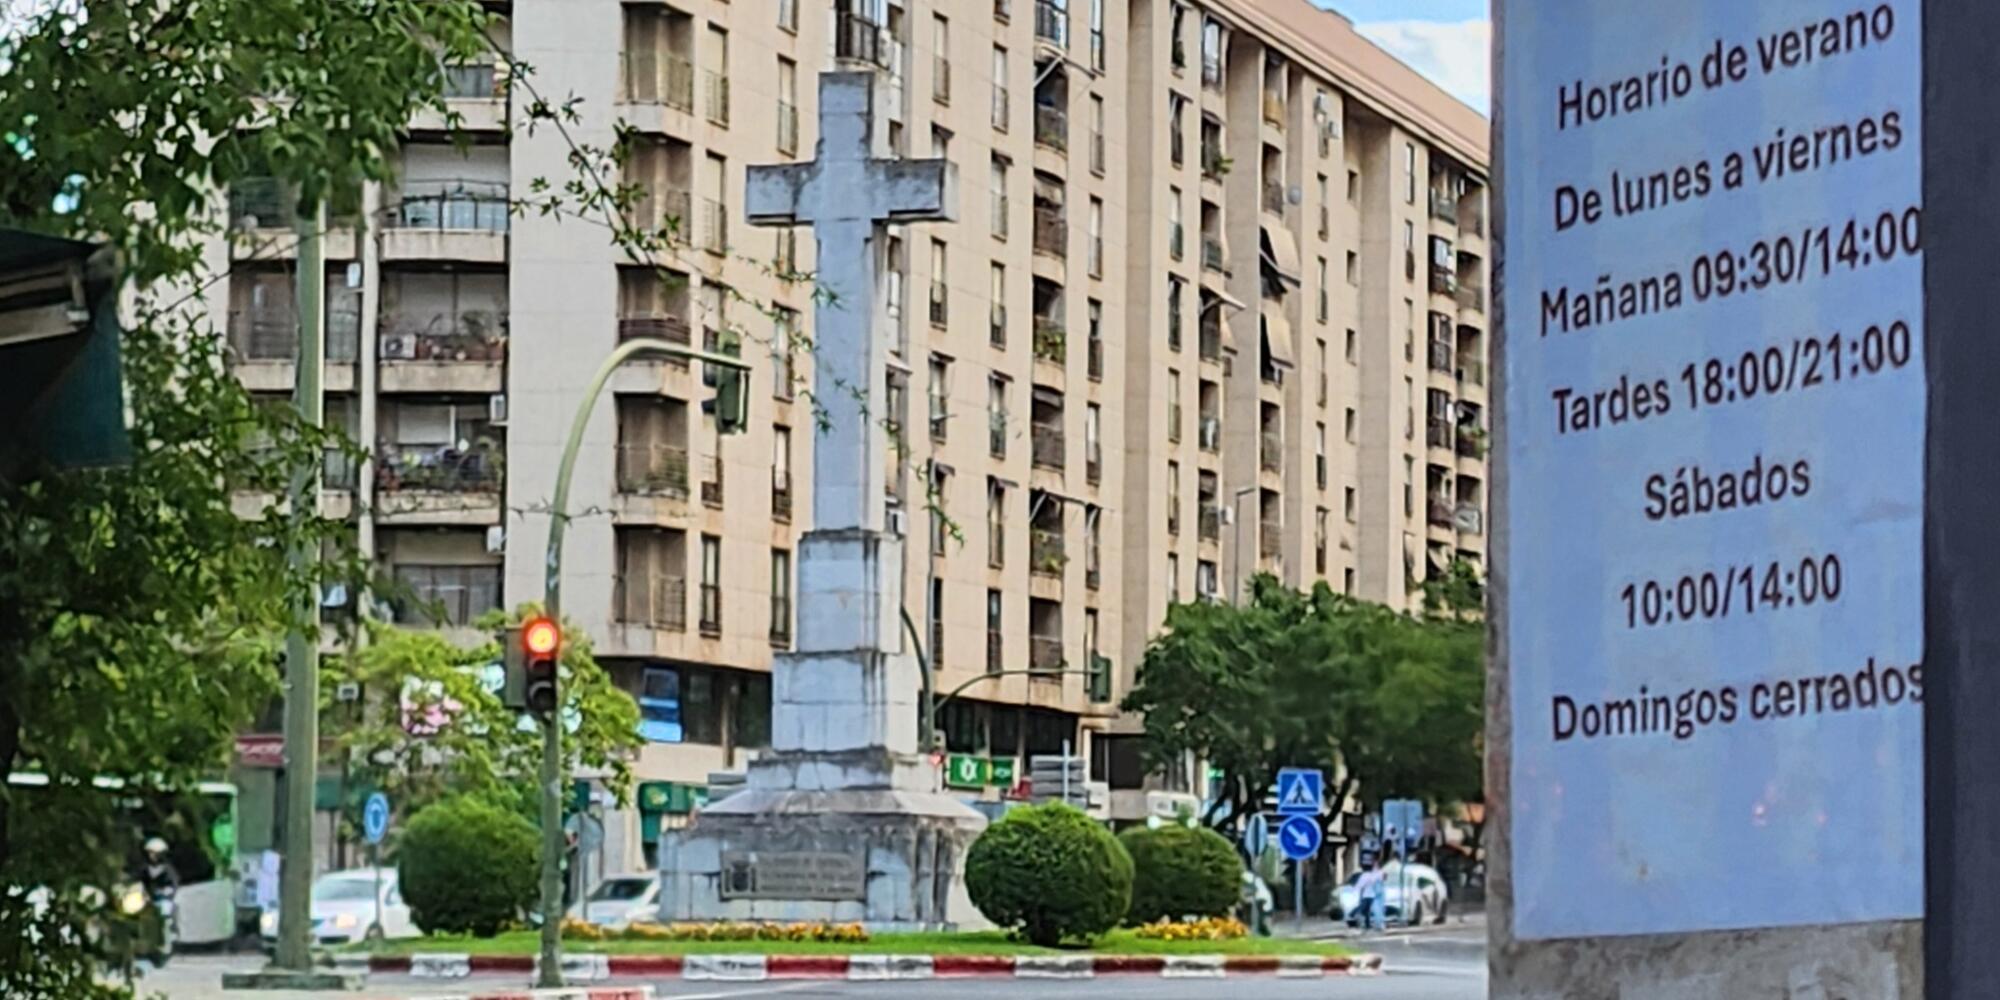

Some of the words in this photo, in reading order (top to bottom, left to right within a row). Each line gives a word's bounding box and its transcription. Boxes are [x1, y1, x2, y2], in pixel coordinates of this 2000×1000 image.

[1558, 55, 1692, 131] Horario
[1700, 38, 1748, 90] de
[1756, 3, 1894, 74] verano
[1554, 184, 1603, 233] De
[1611, 160, 1712, 217] lunes
[1723, 151, 1744, 191] a
[1752, 109, 1902, 182] viernes
[1540, 270, 1682, 338] Mañana
[1692, 205, 1923, 302] 09:30/14:00
[1551, 375, 1671, 435] Tardes
[1681, 319, 1911, 410] 18:00/21:00
[1644, 454, 1811, 521] Sábados
[1621, 553, 1842, 629] 10:00/14:00
[1552, 685, 1738, 742] Domingos
[1750, 657, 1923, 720] cerrados
